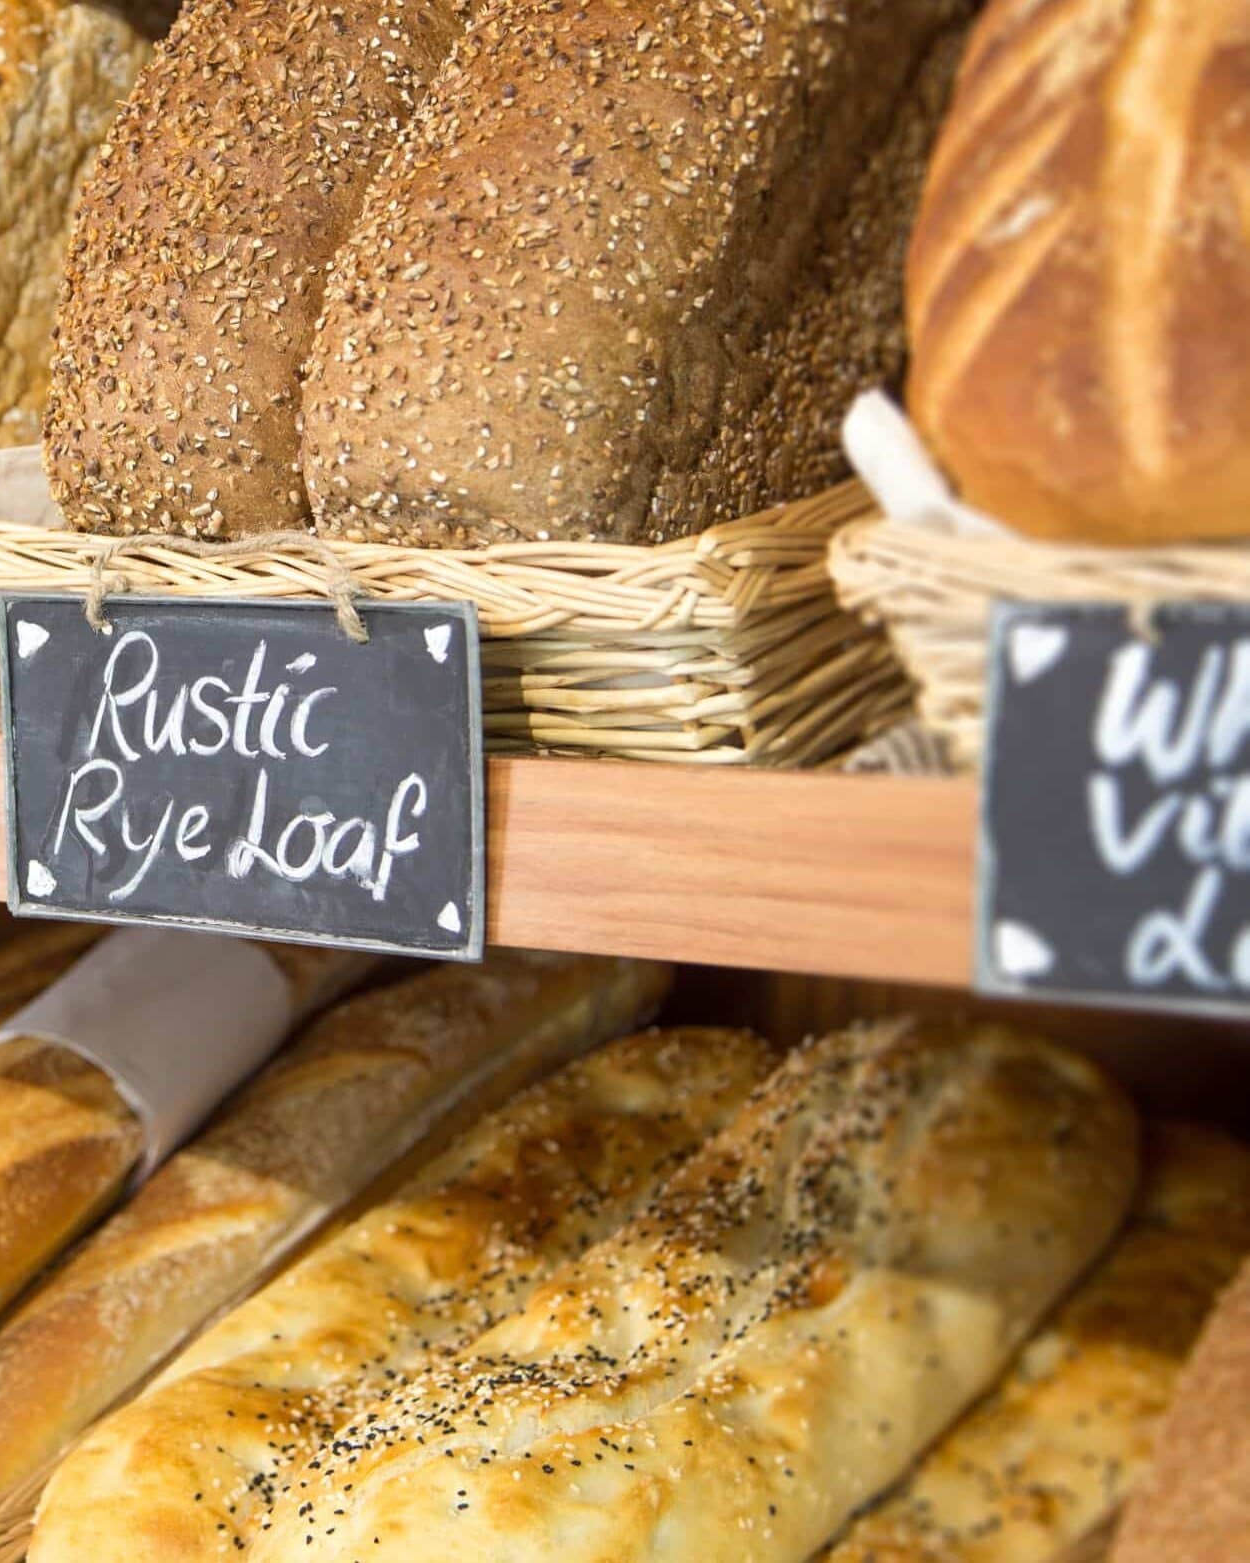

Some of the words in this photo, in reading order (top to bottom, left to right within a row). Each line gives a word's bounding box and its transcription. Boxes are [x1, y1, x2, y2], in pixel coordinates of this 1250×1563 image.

[86, 630, 339, 762] Rustic
[53, 757, 212, 900] Rye
[224, 767, 429, 902] Loaf
